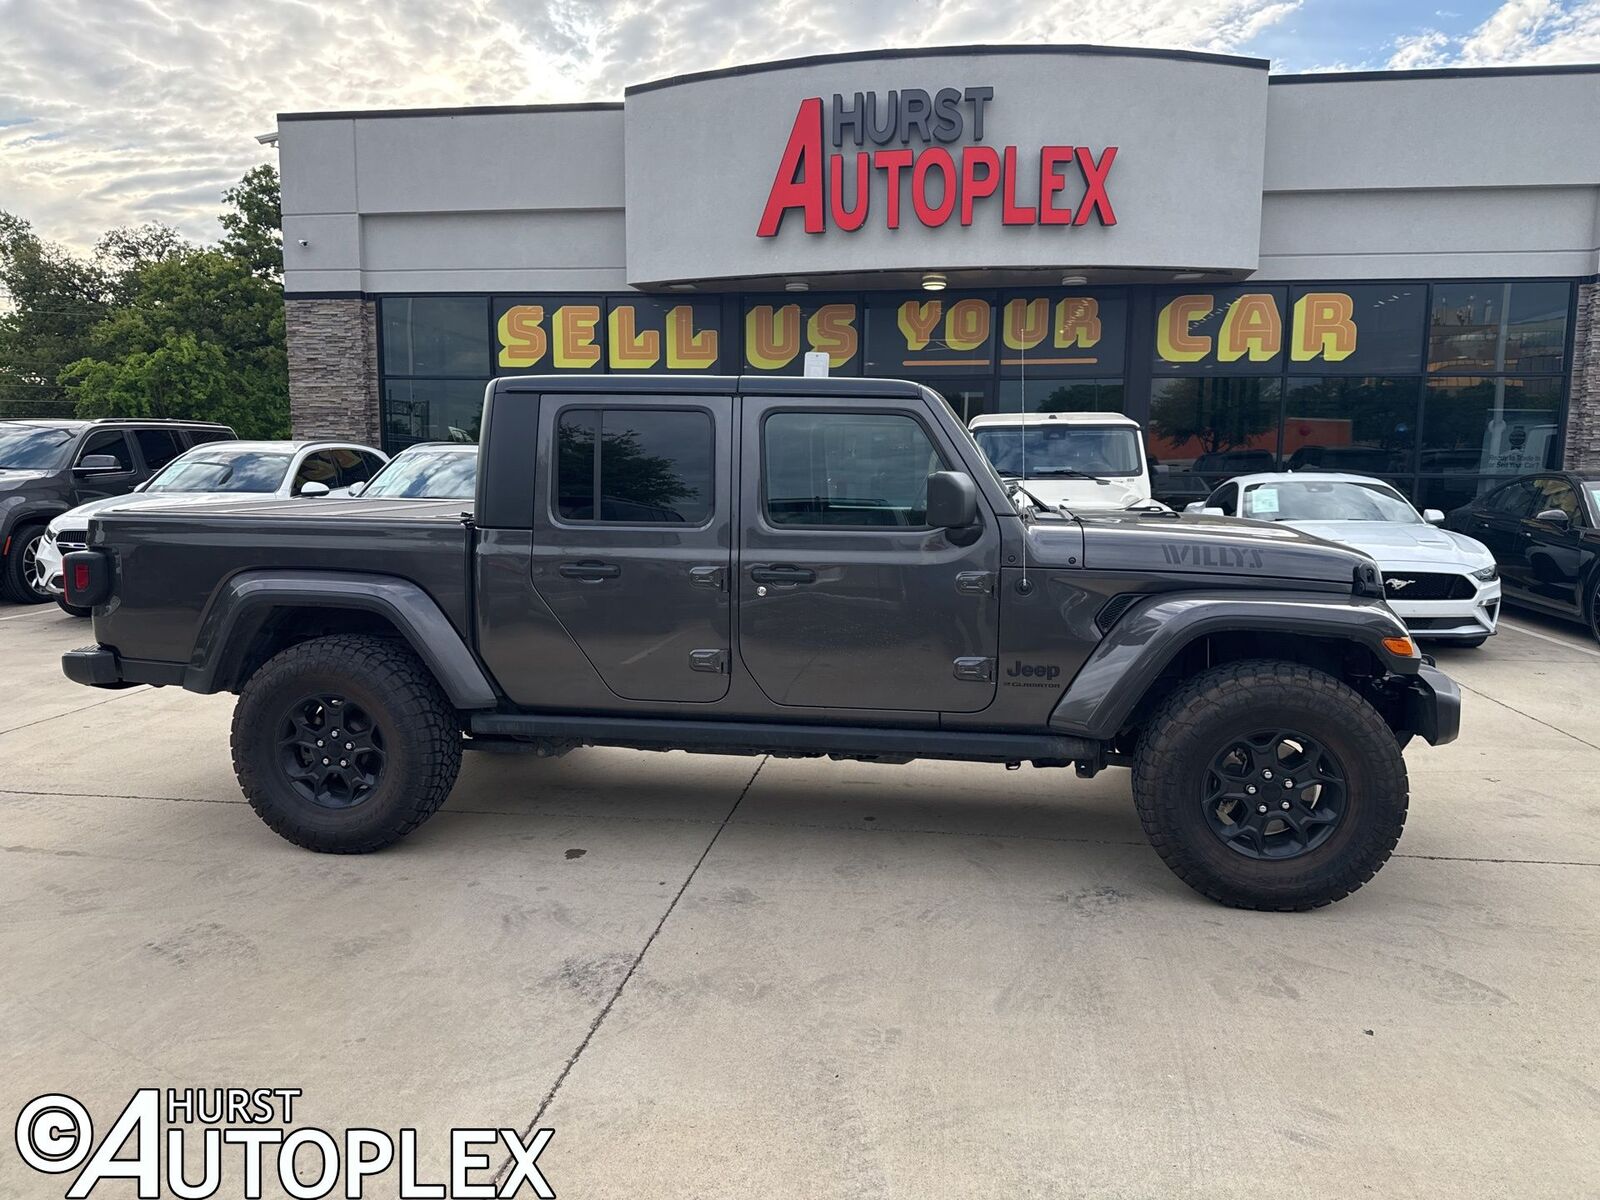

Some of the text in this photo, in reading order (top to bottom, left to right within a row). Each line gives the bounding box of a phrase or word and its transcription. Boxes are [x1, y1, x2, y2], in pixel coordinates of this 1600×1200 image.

[833, 86, 994, 147] HURST
[756, 97, 1119, 238] AUTOPLEX
[498, 292, 1358, 370] SELL US YOUR CAR
[1162, 544, 1264, 569] WILLYS
[1007, 660, 1060, 681] Jeep
